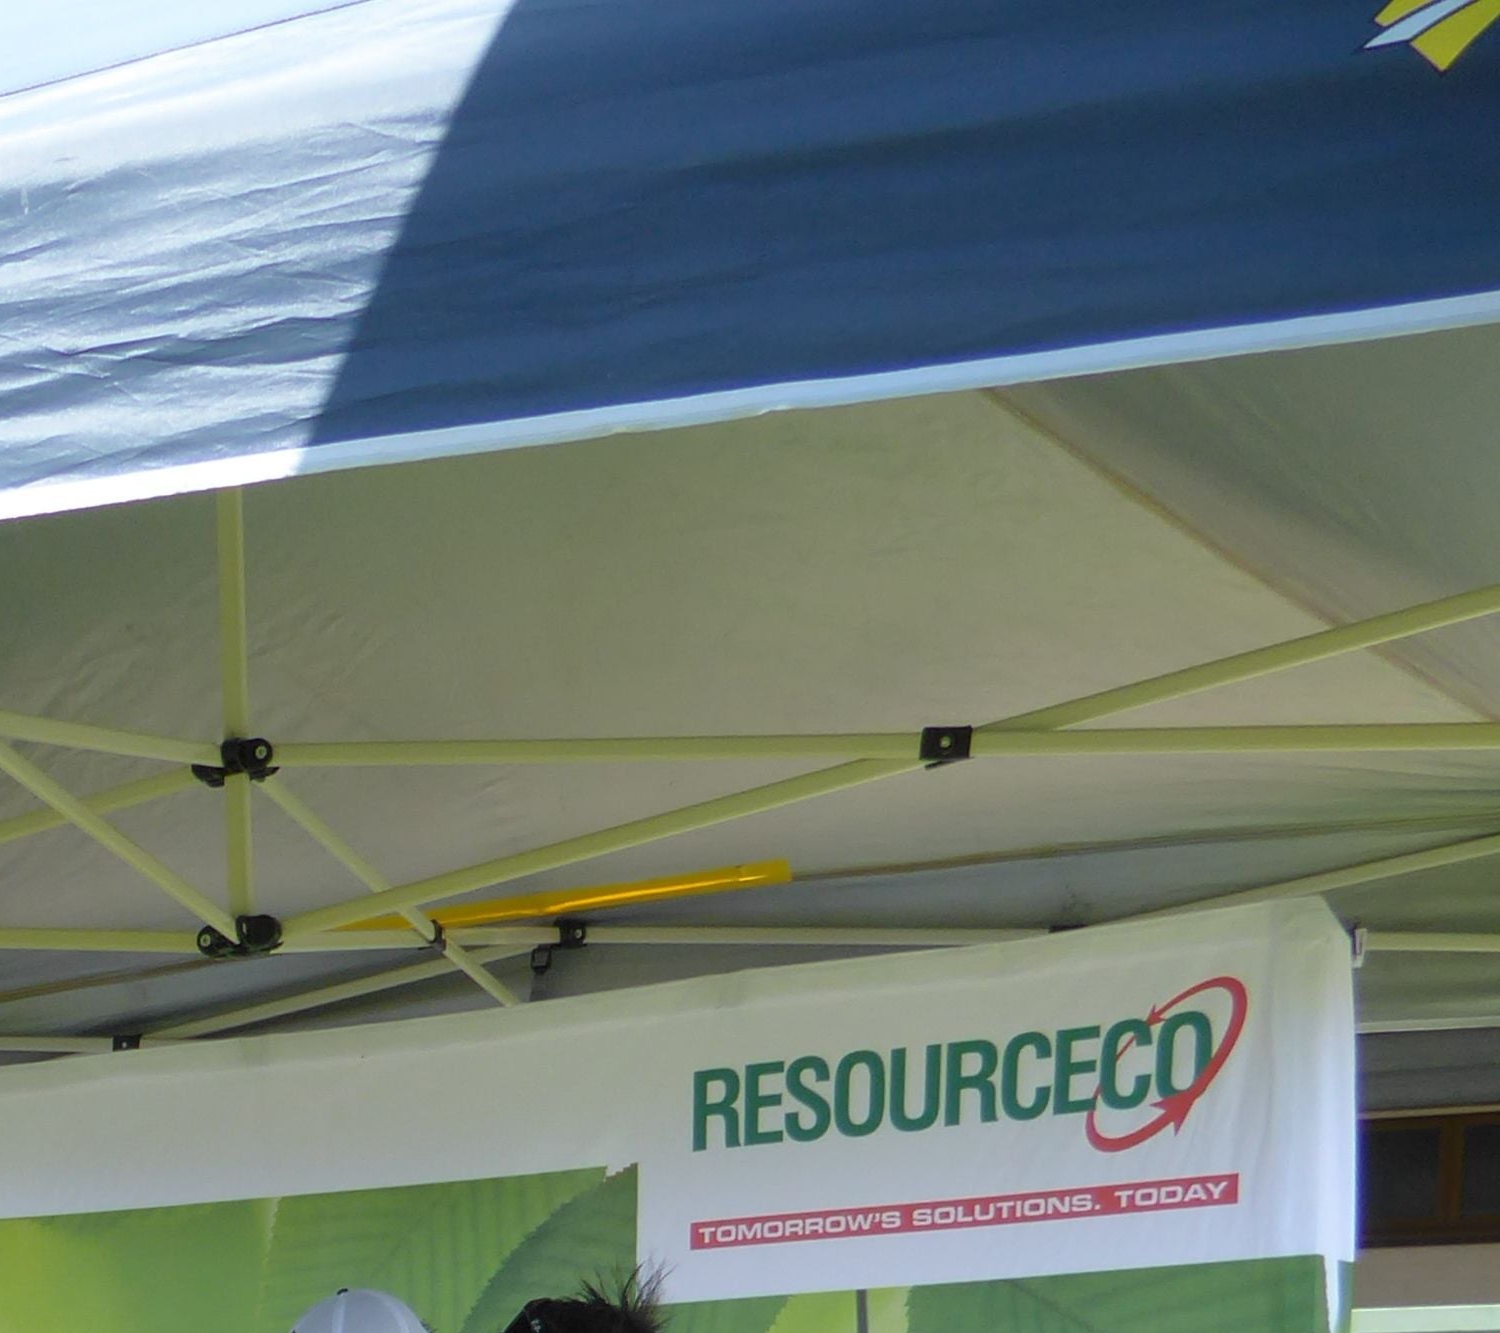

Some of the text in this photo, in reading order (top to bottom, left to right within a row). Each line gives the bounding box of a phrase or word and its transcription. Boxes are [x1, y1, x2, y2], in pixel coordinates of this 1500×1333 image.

[691, 1010, 1213, 1153] RESOURCECO
[699, 1180, 1228, 1245] TOMORROW'S SOLUTIONS. TODAY
